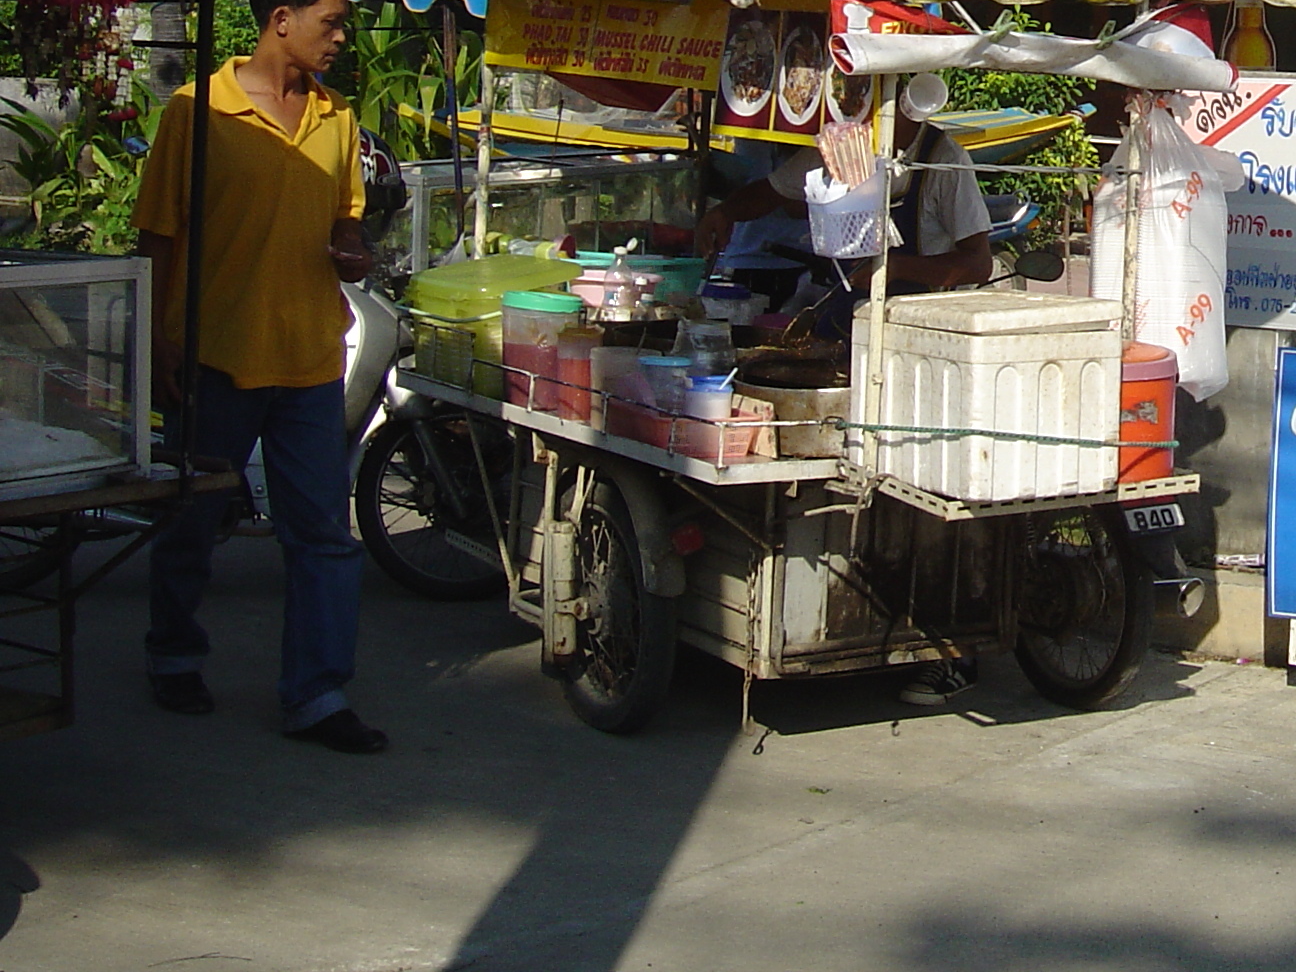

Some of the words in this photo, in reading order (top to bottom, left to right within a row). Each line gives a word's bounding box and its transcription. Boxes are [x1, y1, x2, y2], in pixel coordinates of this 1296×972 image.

[639, 34, 675, 53] CHILI
[676, 37, 724, 59] SAUCE
[1170, 171, 1205, 220] A-99
[1175, 294, 1213, 346] A-99
